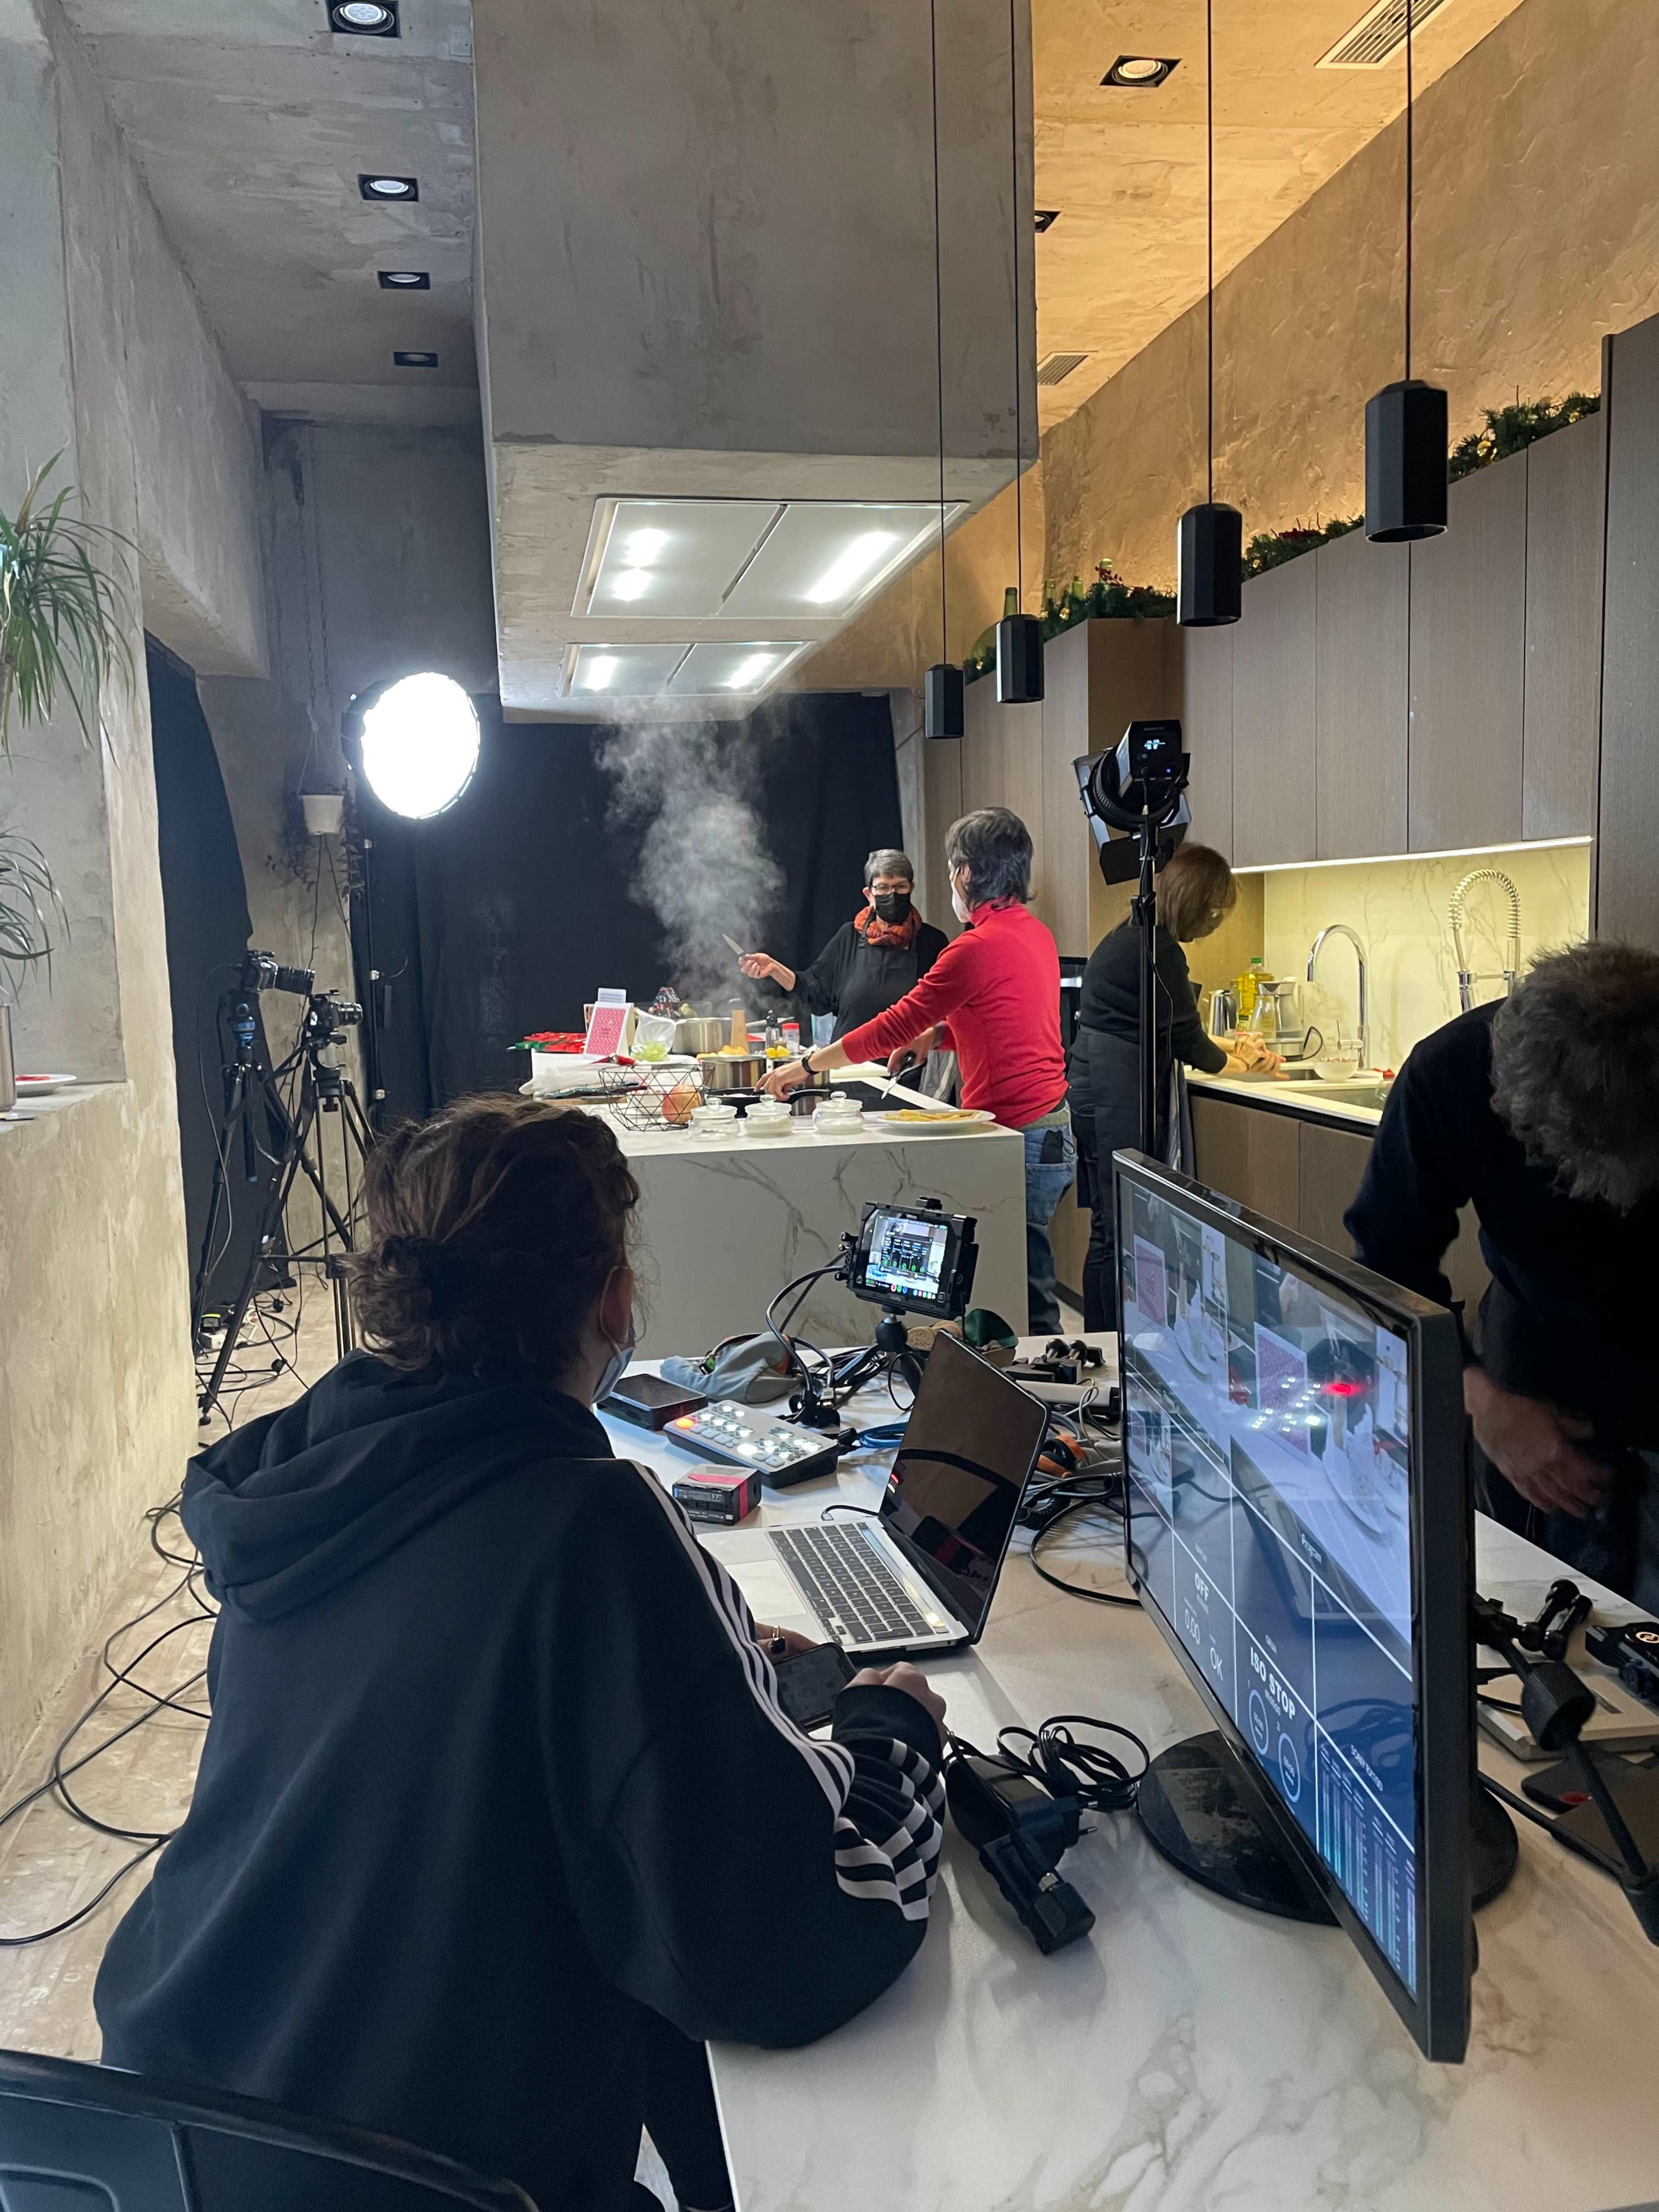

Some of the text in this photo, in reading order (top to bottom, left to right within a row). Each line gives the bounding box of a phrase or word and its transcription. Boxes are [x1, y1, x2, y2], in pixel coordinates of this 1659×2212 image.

[1195, 1572, 1209, 1601] OFF
[1185, 1608, 1200, 1645] 0.00
[1210, 1647, 1223, 1681] OK
[1250, 1646, 1267, 1682] ISO
[1269, 1673, 1295, 1719] STOP
